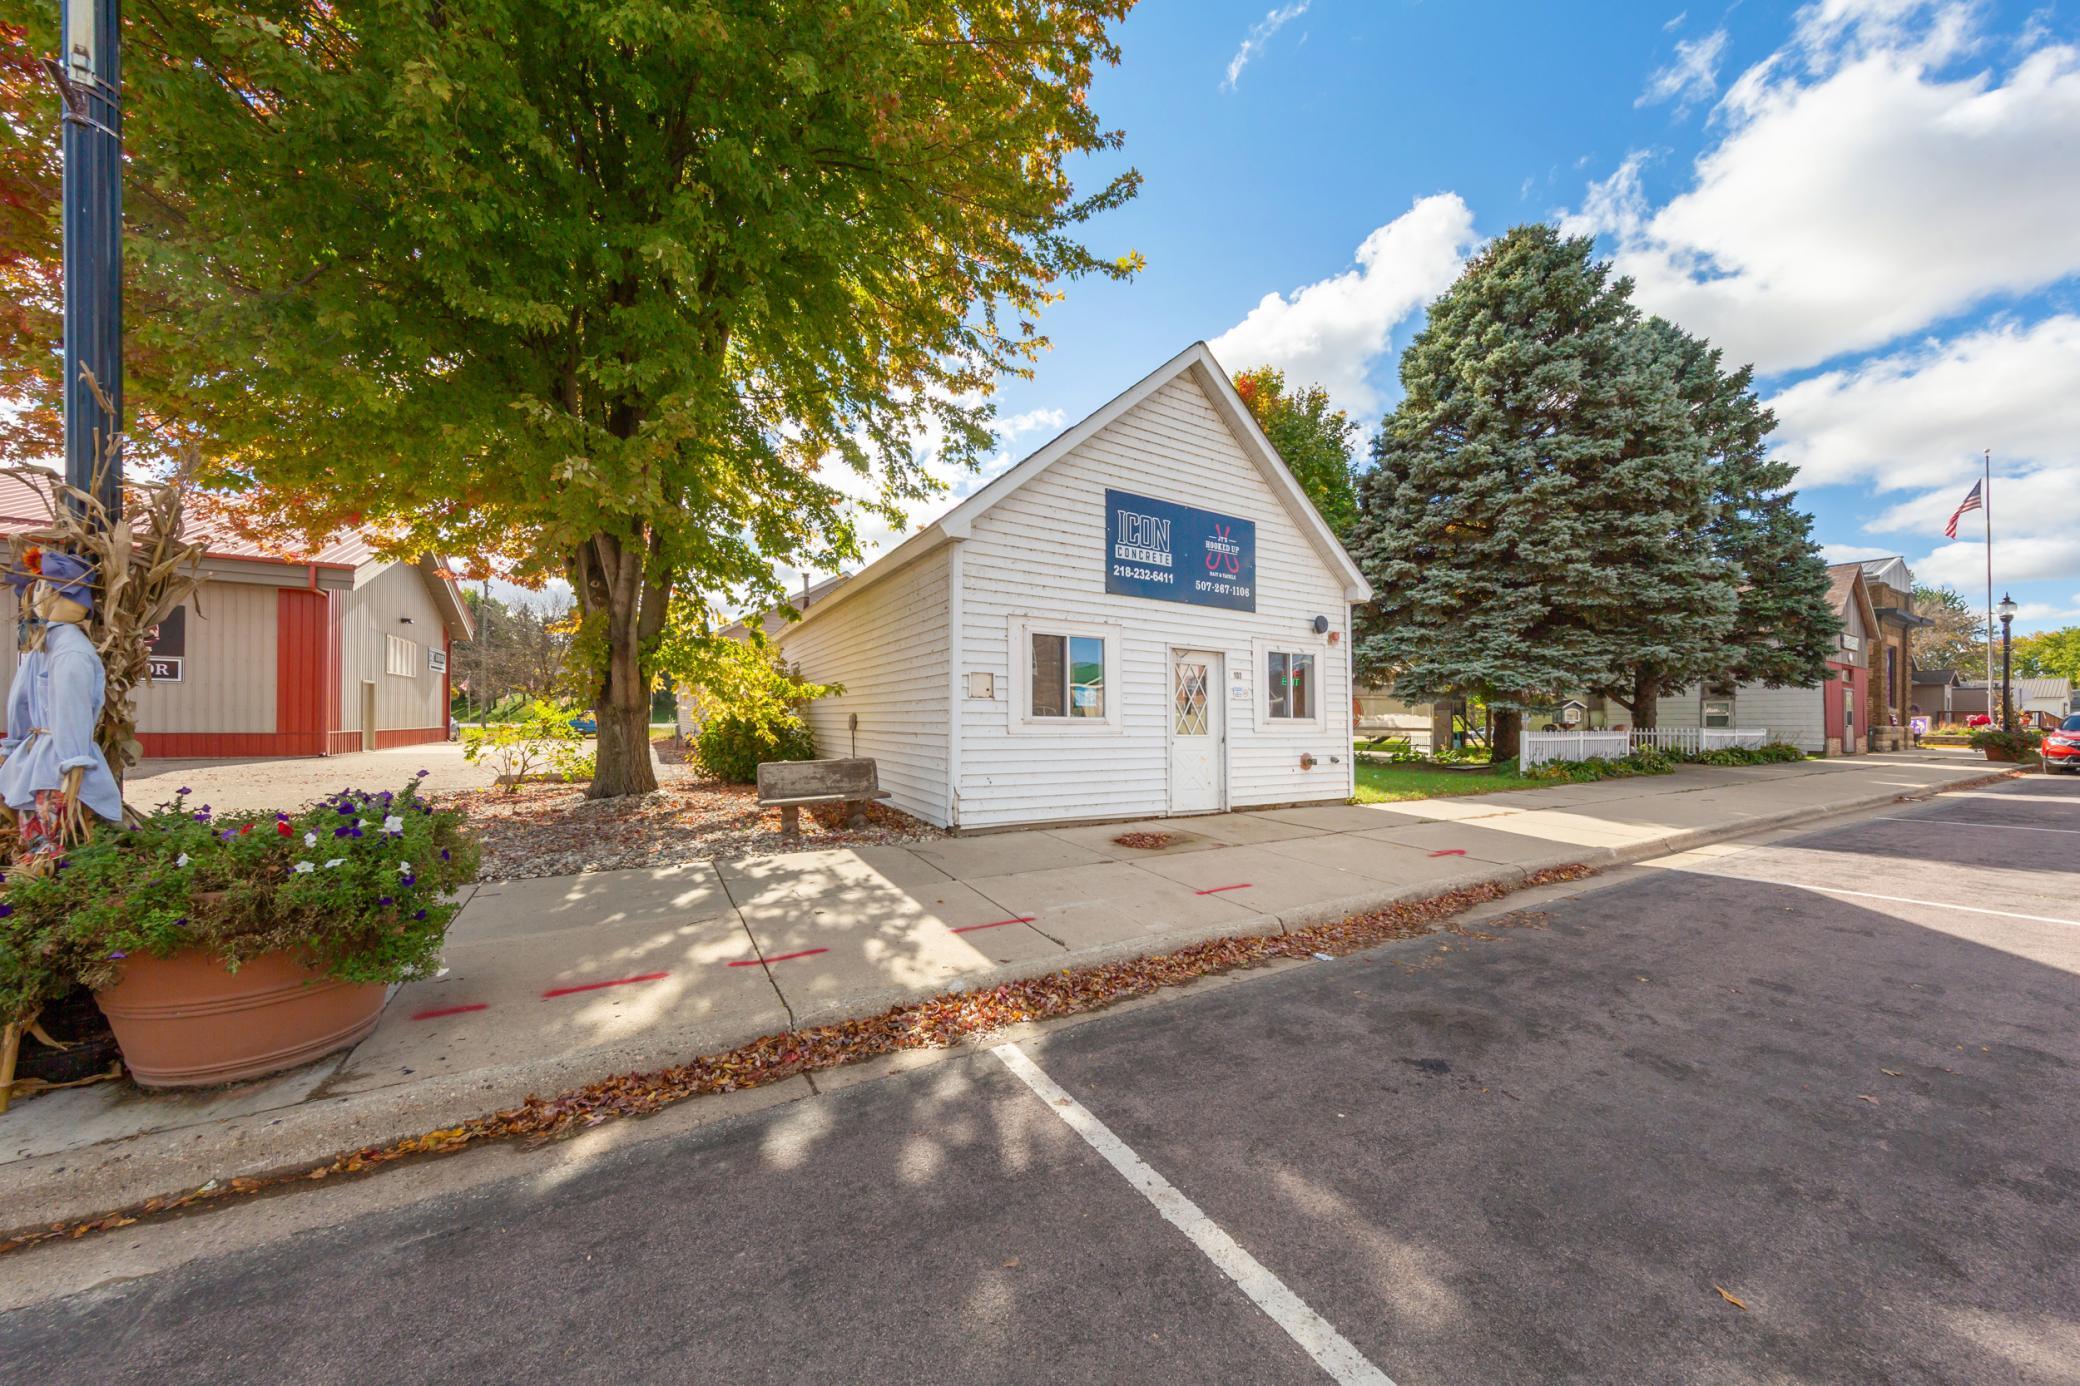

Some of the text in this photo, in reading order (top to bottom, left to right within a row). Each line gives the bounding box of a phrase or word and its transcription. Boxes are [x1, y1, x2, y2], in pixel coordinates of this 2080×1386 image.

[1117, 509, 1171, 553] ICON
[1116, 545, 1172, 566] CONCRETE
[1205, 540, 1240, 554] HOOKED UP
[1113, 565, 1174, 584] 218-232-6411
[1195, 580, 1250, 598] 507-267-1106
